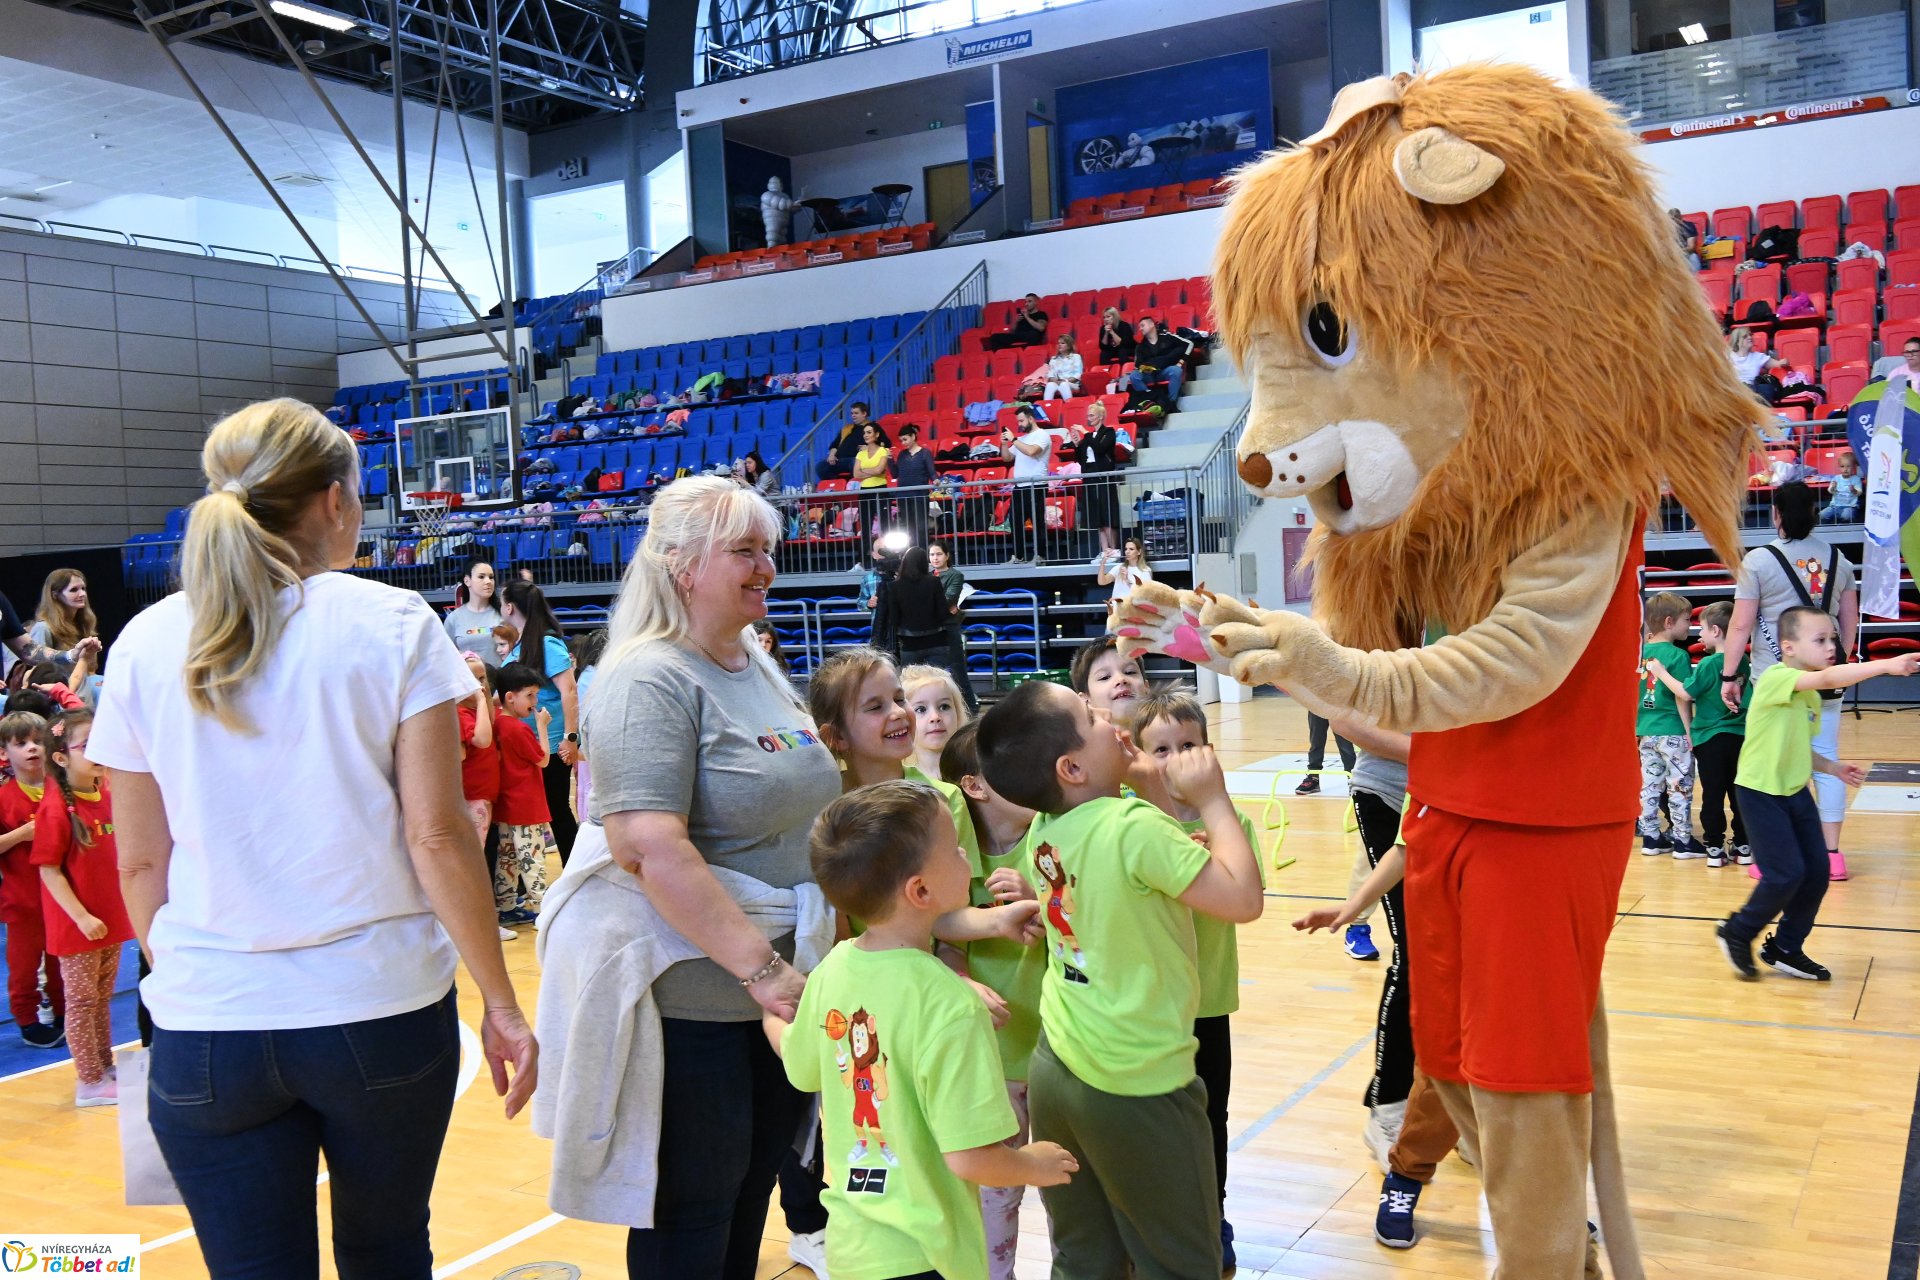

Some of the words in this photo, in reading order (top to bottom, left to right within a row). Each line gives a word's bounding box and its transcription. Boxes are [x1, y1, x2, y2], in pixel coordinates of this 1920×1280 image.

[963, 33, 1030, 56] MICHELIN
[1785, 97, 1854, 120] Continental
[1670, 115, 1735, 137] Continental
